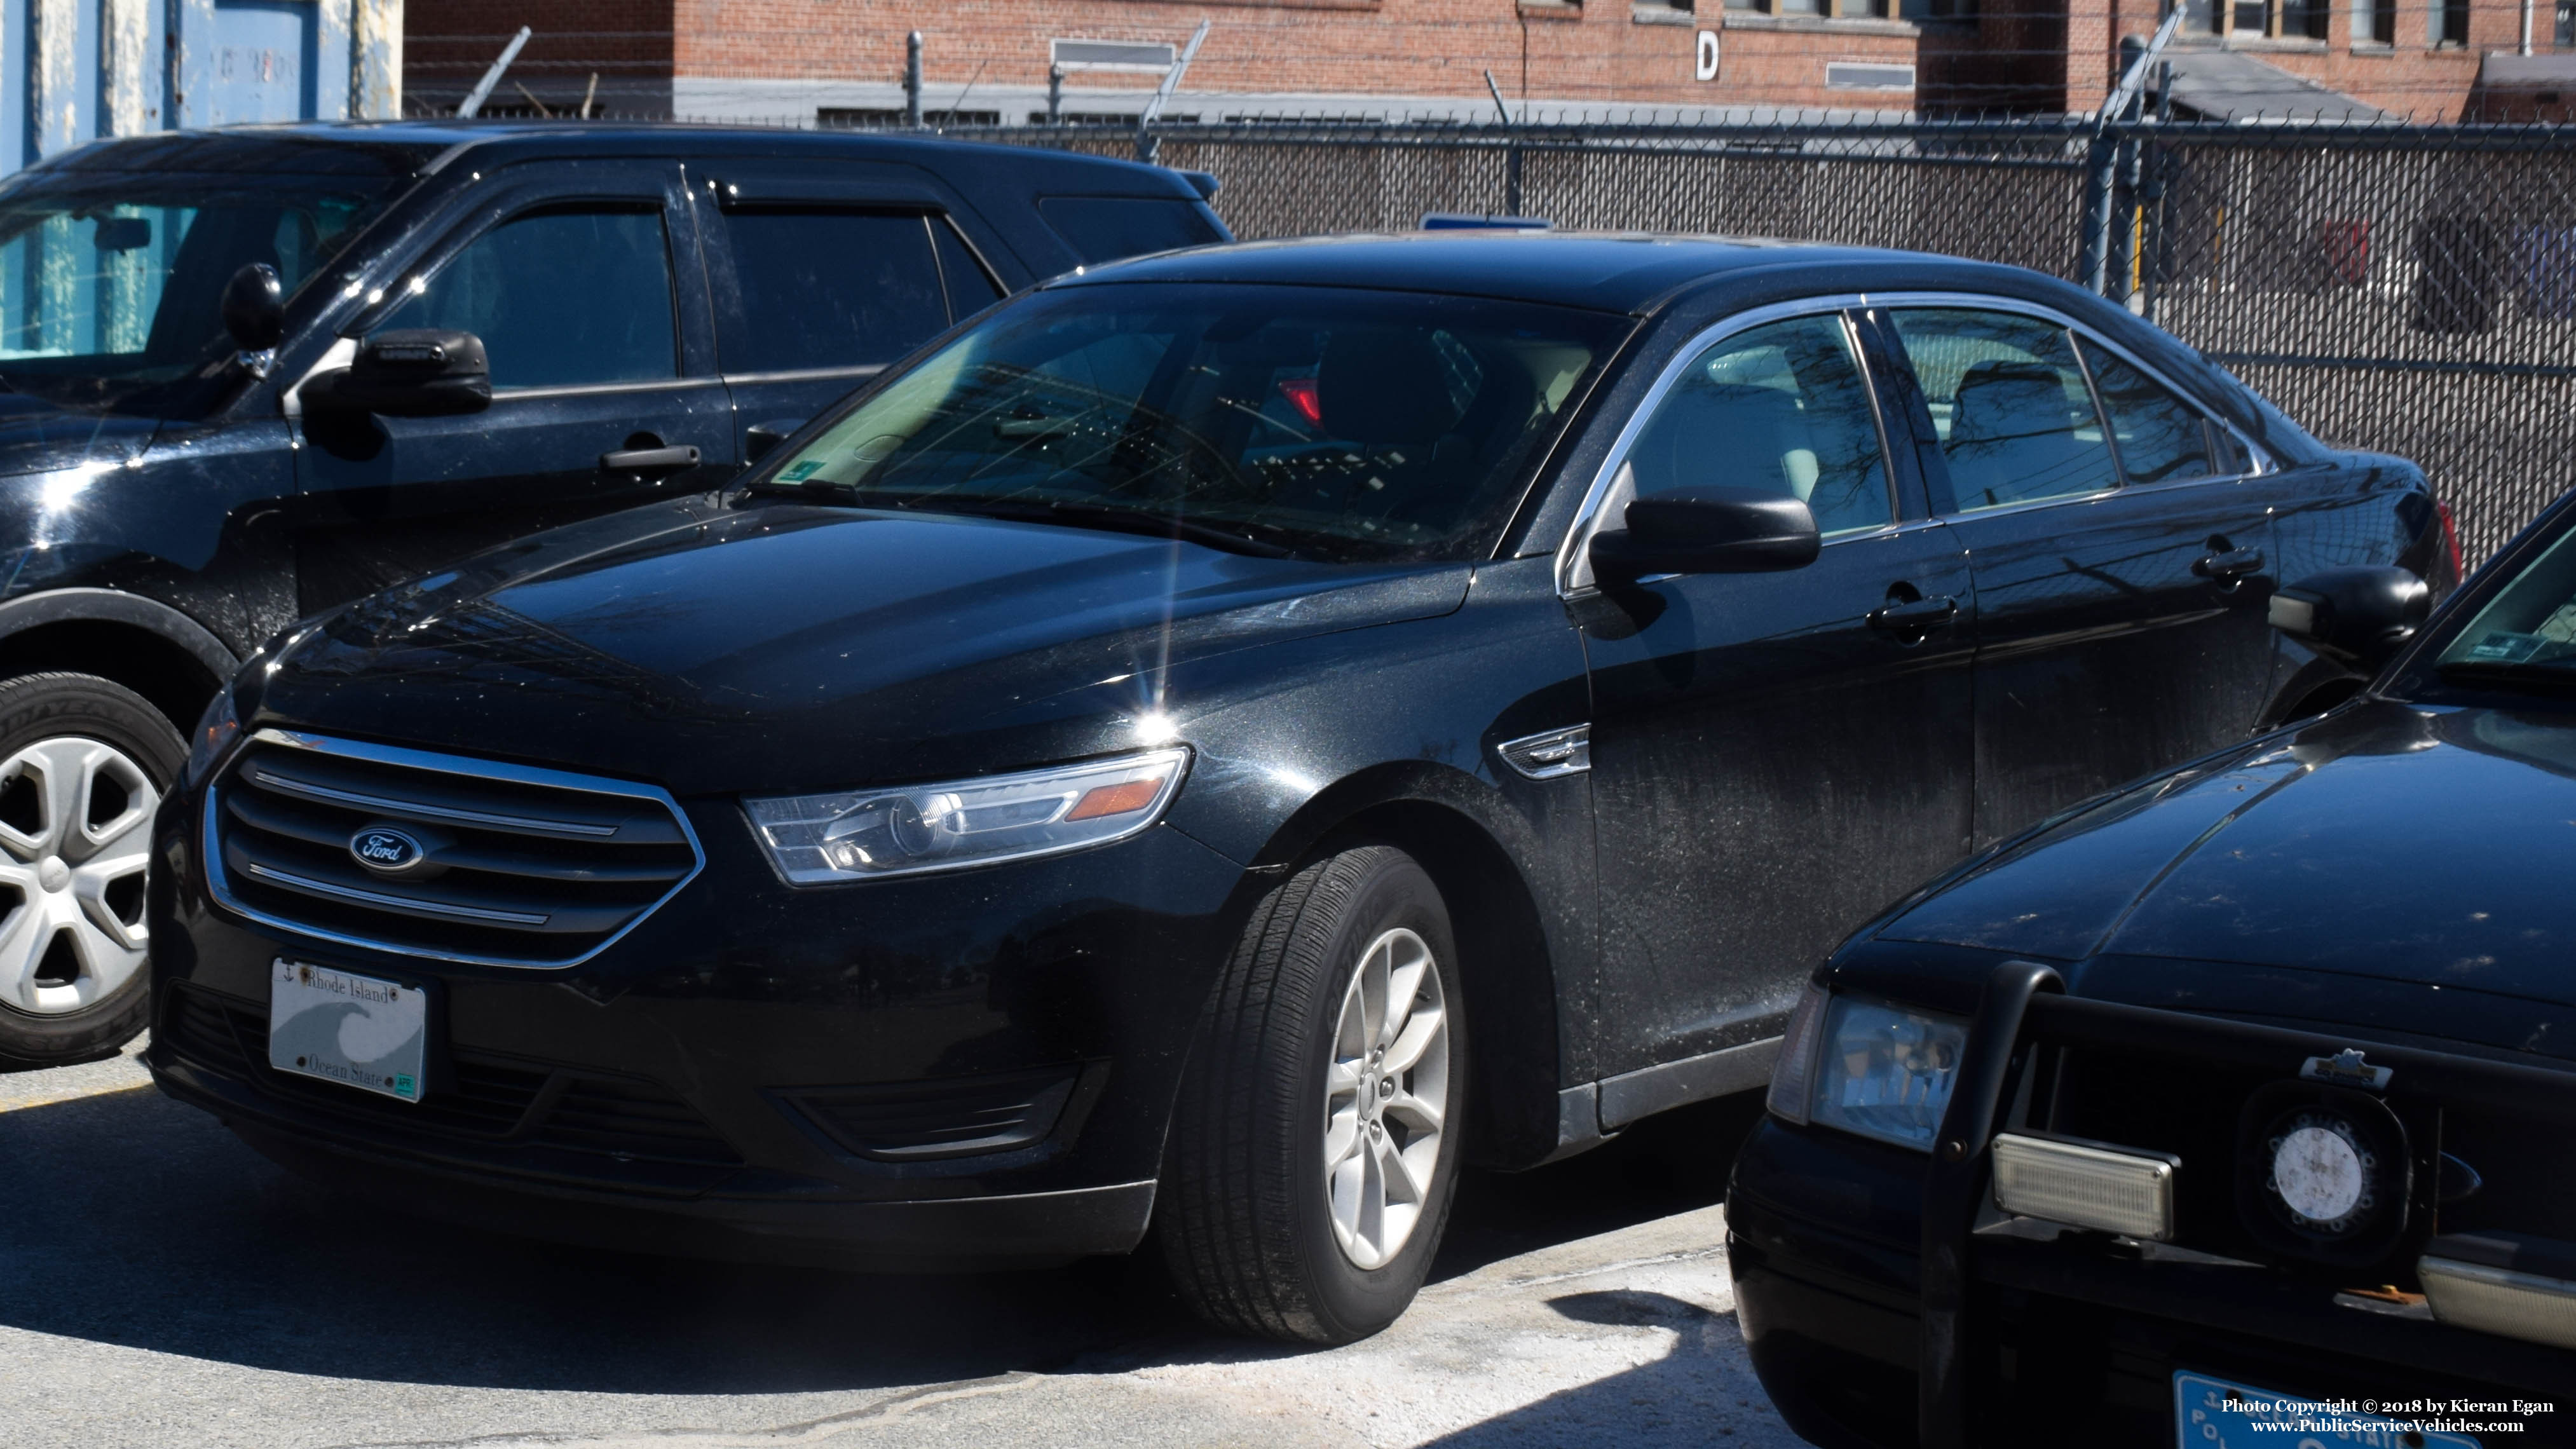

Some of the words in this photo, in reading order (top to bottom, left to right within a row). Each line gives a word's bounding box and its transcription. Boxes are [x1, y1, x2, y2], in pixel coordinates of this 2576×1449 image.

[1696, 30, 1719, 80] D
[363, 834, 403, 861] Ford
[308, 970, 346, 995] Rhode
[350, 979, 388, 1003] Island
[309, 1053, 348, 1079] Ocean
[350, 1062, 383, 1088] State
